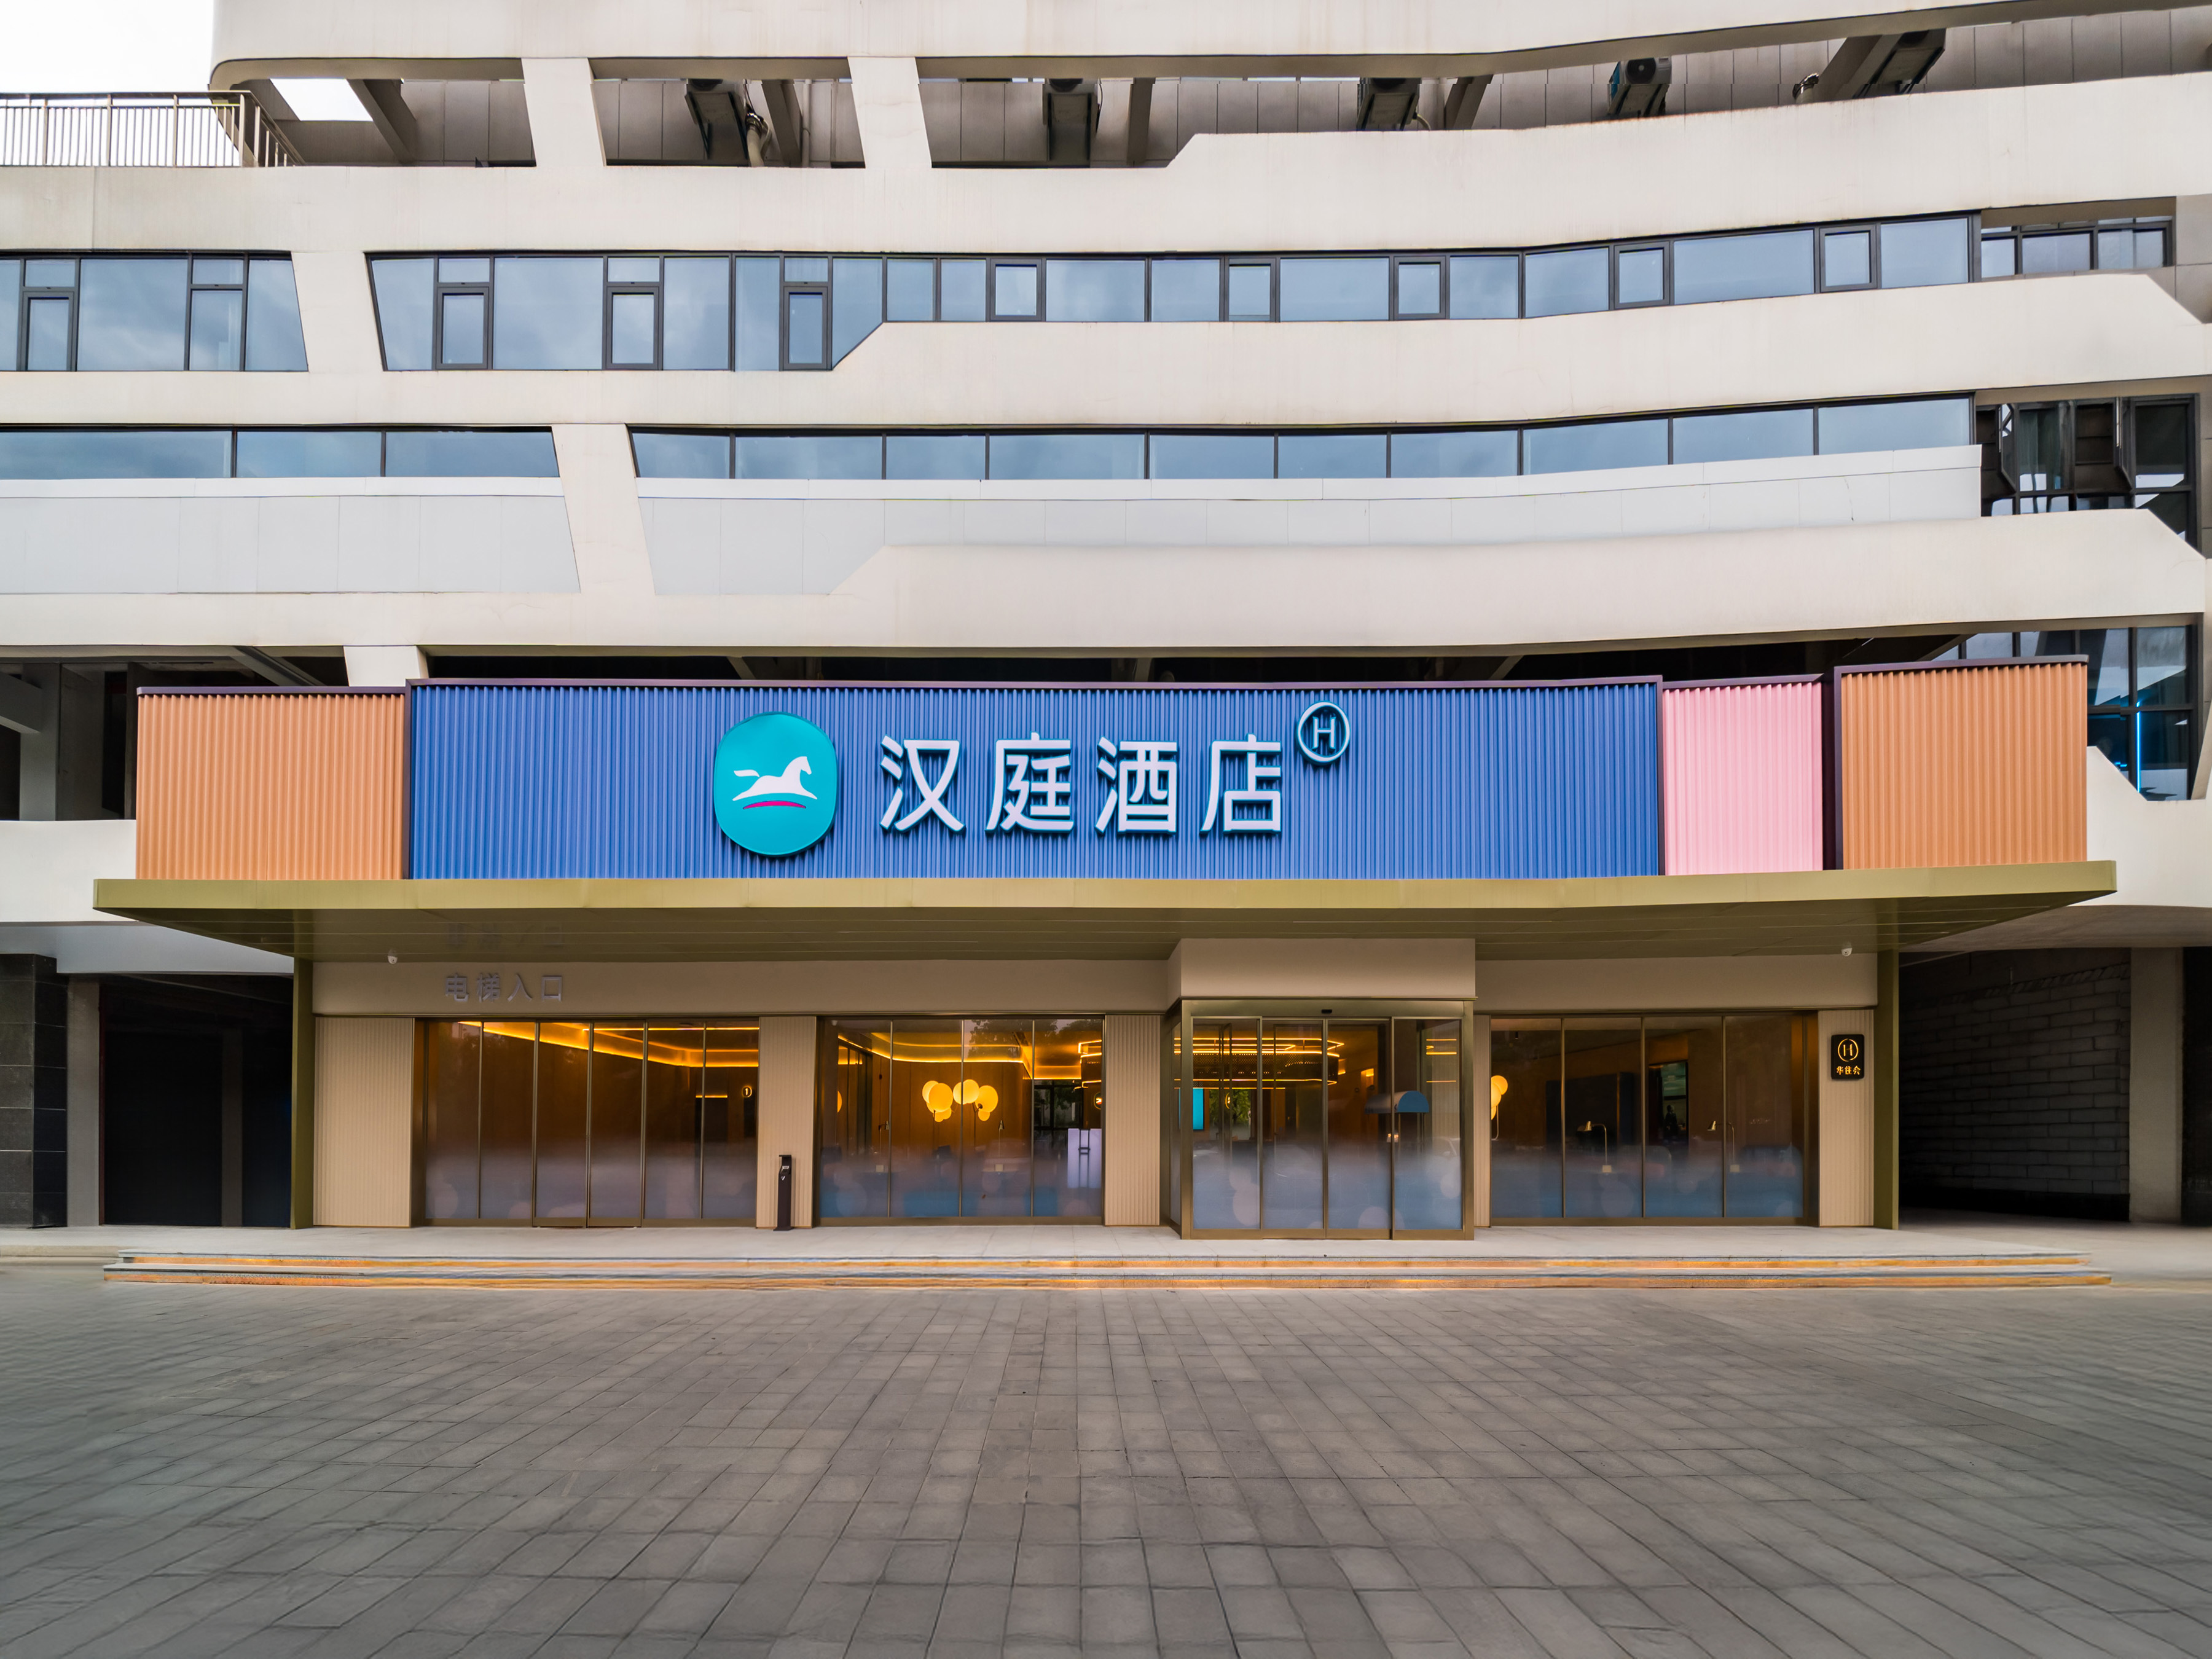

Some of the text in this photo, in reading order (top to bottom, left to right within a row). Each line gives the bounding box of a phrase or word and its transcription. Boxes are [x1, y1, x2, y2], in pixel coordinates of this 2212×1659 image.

[879, 731, 1283, 834] 汉庭酒店
[445, 973, 563, 1002] 电梯入口
[1837, 1065, 1861, 1075] 华住会
